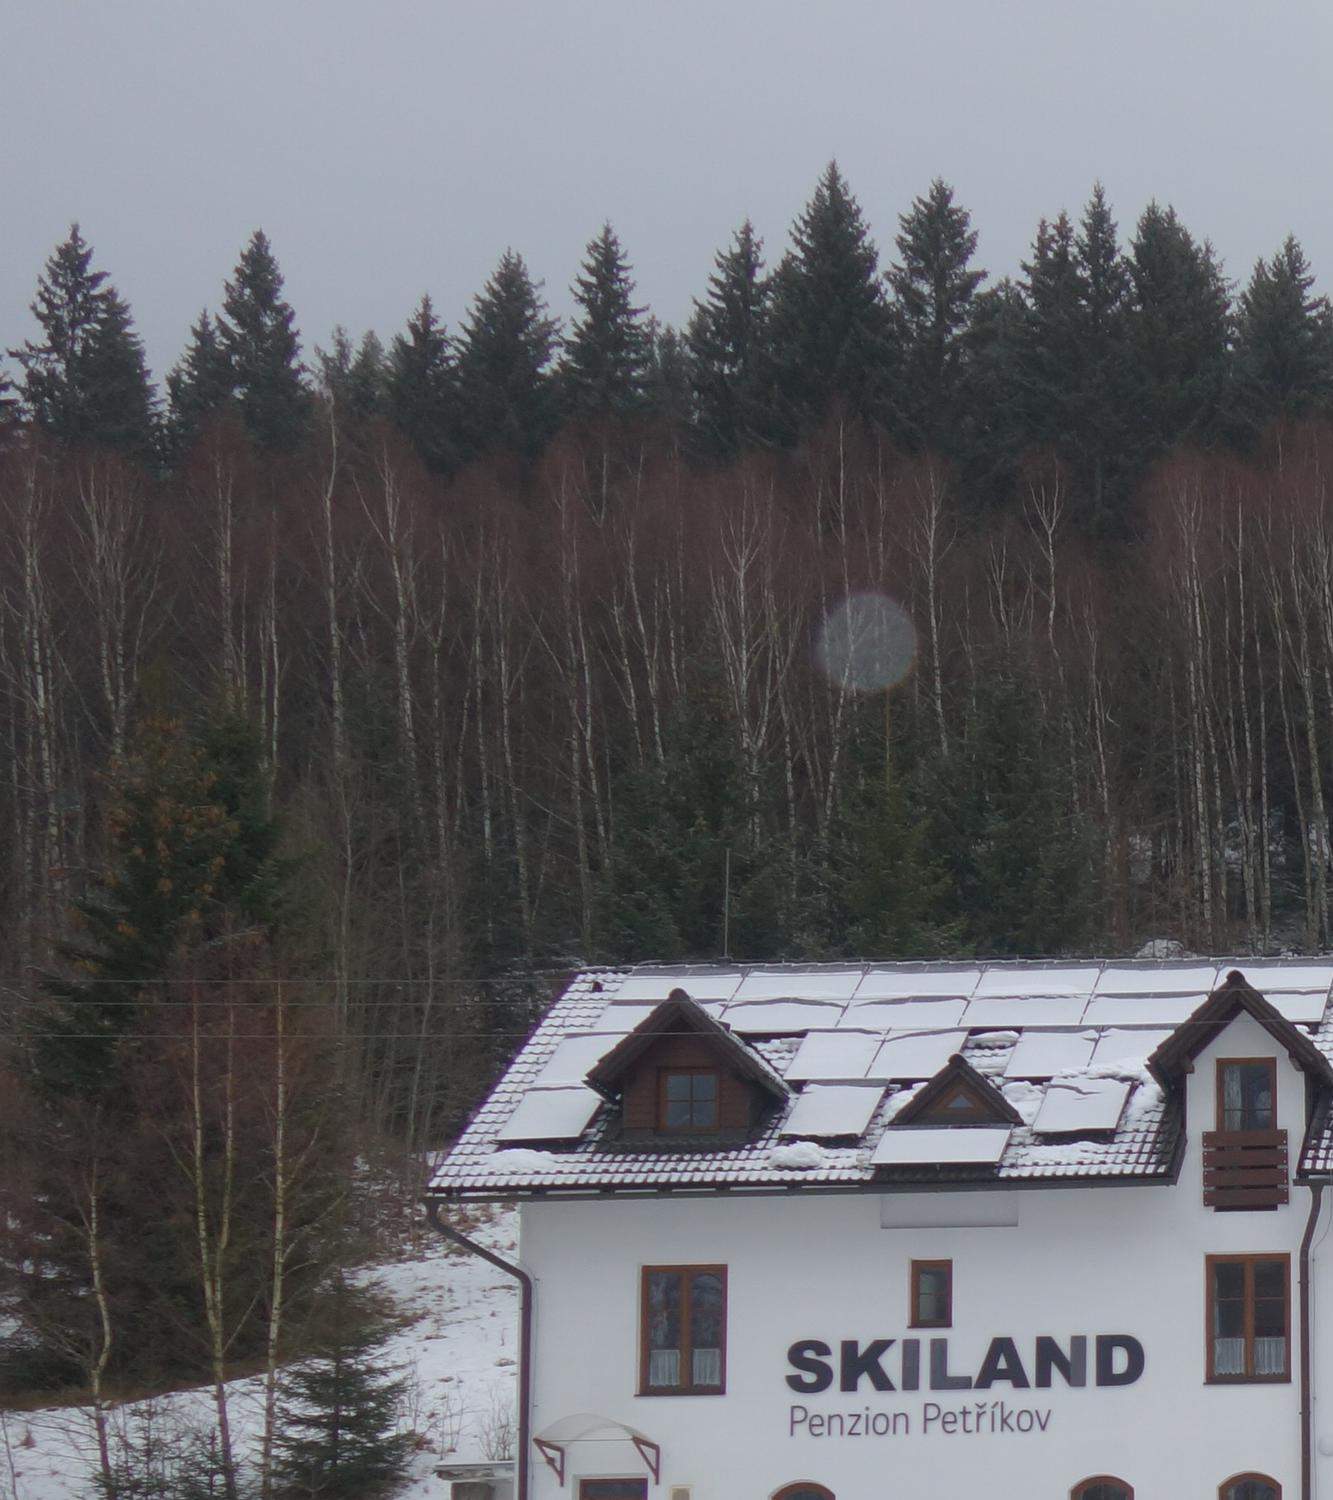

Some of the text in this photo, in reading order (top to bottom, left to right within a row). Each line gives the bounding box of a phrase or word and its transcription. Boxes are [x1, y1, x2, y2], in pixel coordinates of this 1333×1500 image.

[785, 1334, 1145, 1393] SKILAND
[789, 1400, 1052, 1437] Penzion Petříkov
